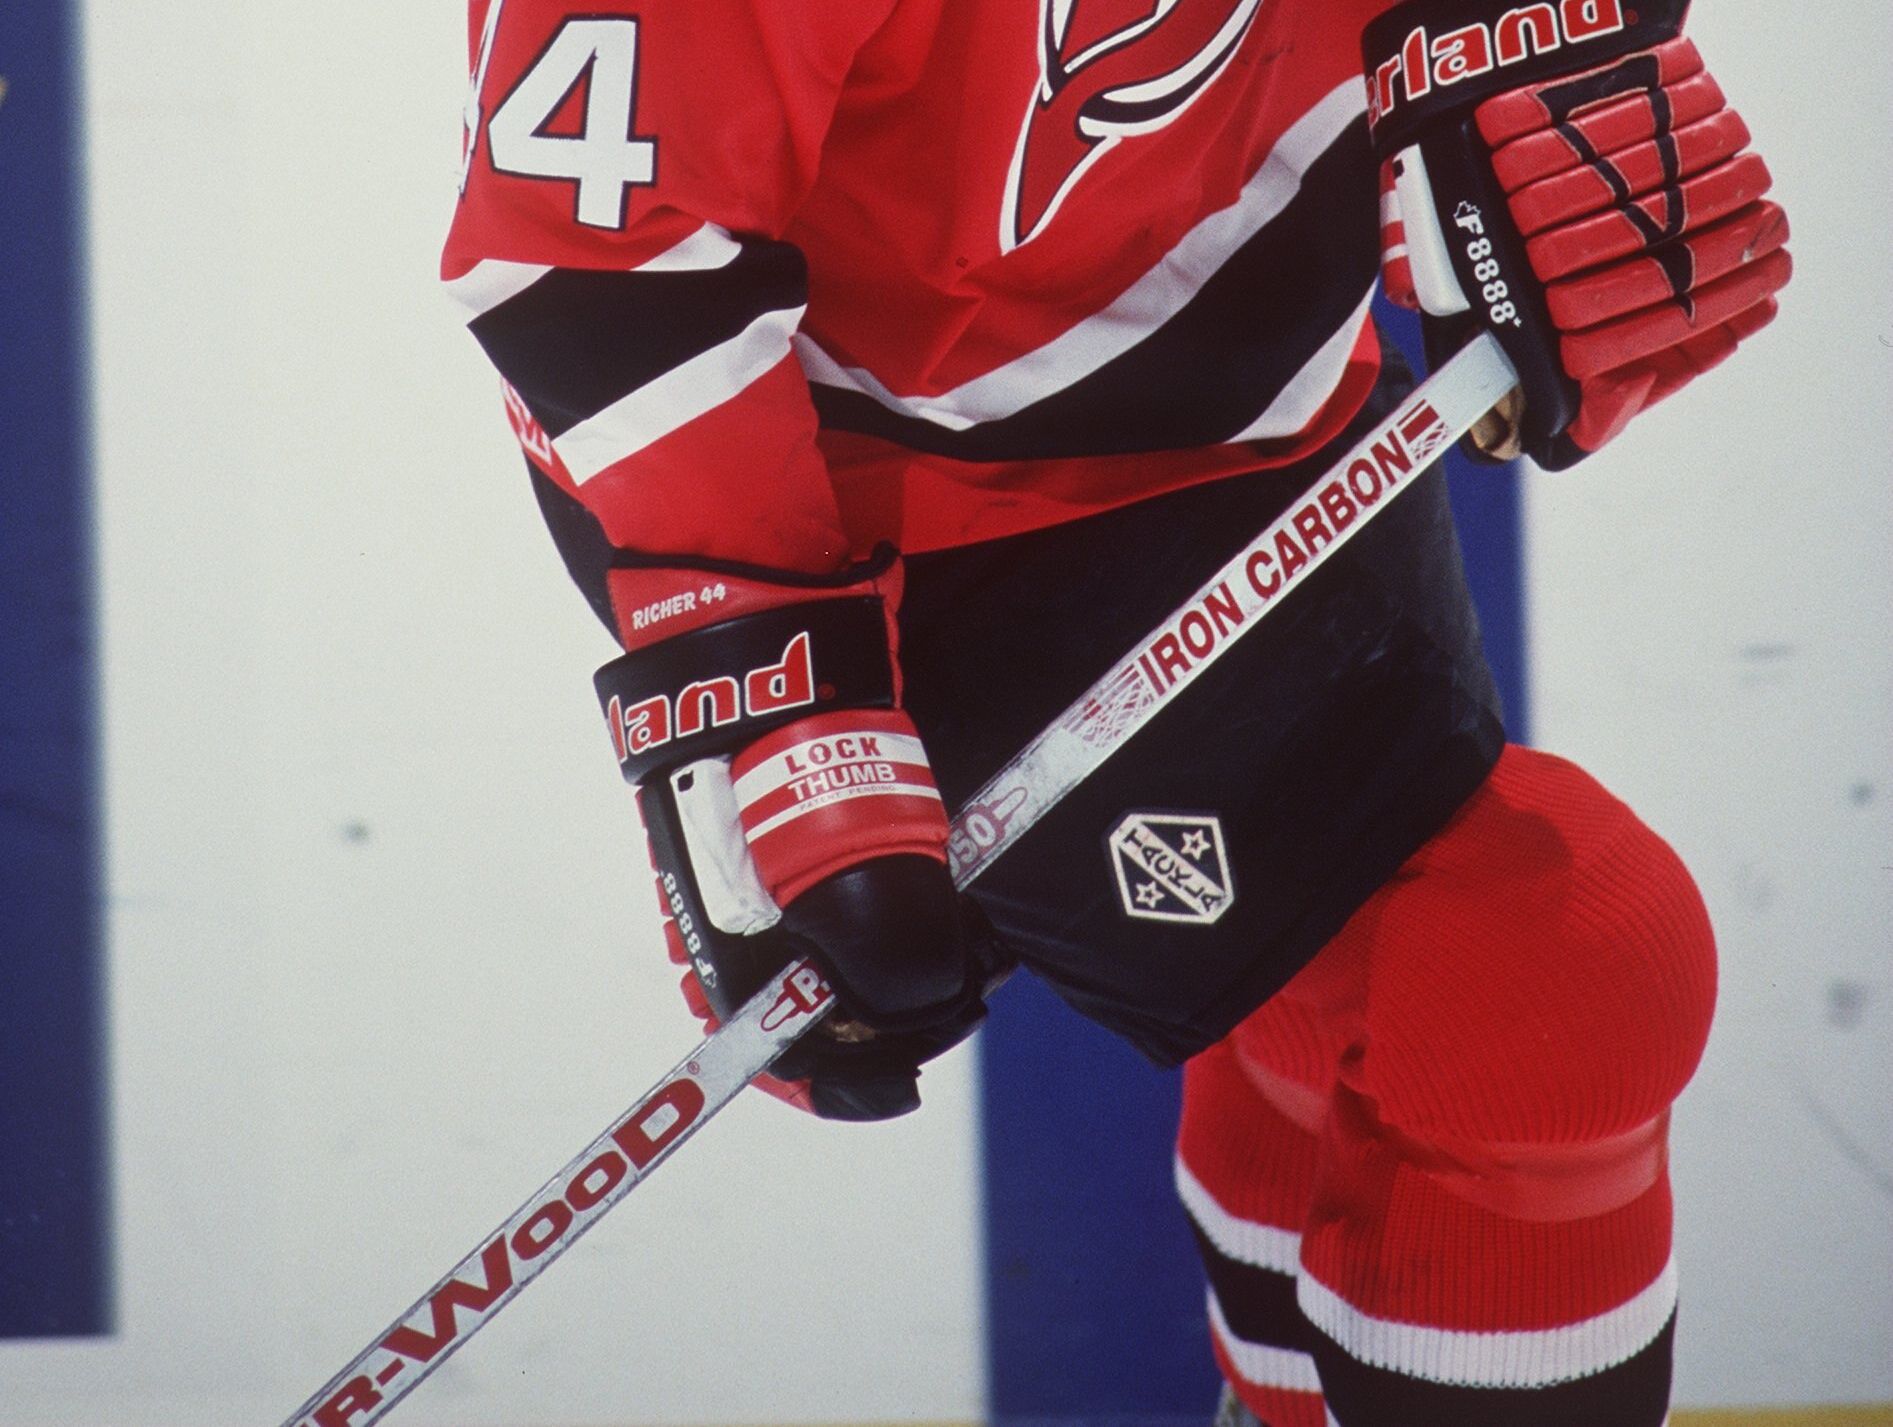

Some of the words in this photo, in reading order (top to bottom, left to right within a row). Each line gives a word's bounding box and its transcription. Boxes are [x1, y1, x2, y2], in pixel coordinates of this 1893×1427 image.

[1138, 580, 1245, 697] IRON
[1245, 429, 1413, 600] CARBON
[632, 591, 697, 631] RICHER
[699, 582, 727, 605] 44
[608, 631, 816, 765] land
[784, 736, 882, 776] LOCK
[787, 763, 897, 802] THUMB
[799, 791, 842, 813] PATENT
[848, 784, 896, 796] PENDING
[1123, 827, 1224, 913] TACKLA
[300, 1077, 705, 1427] R-WOOD
